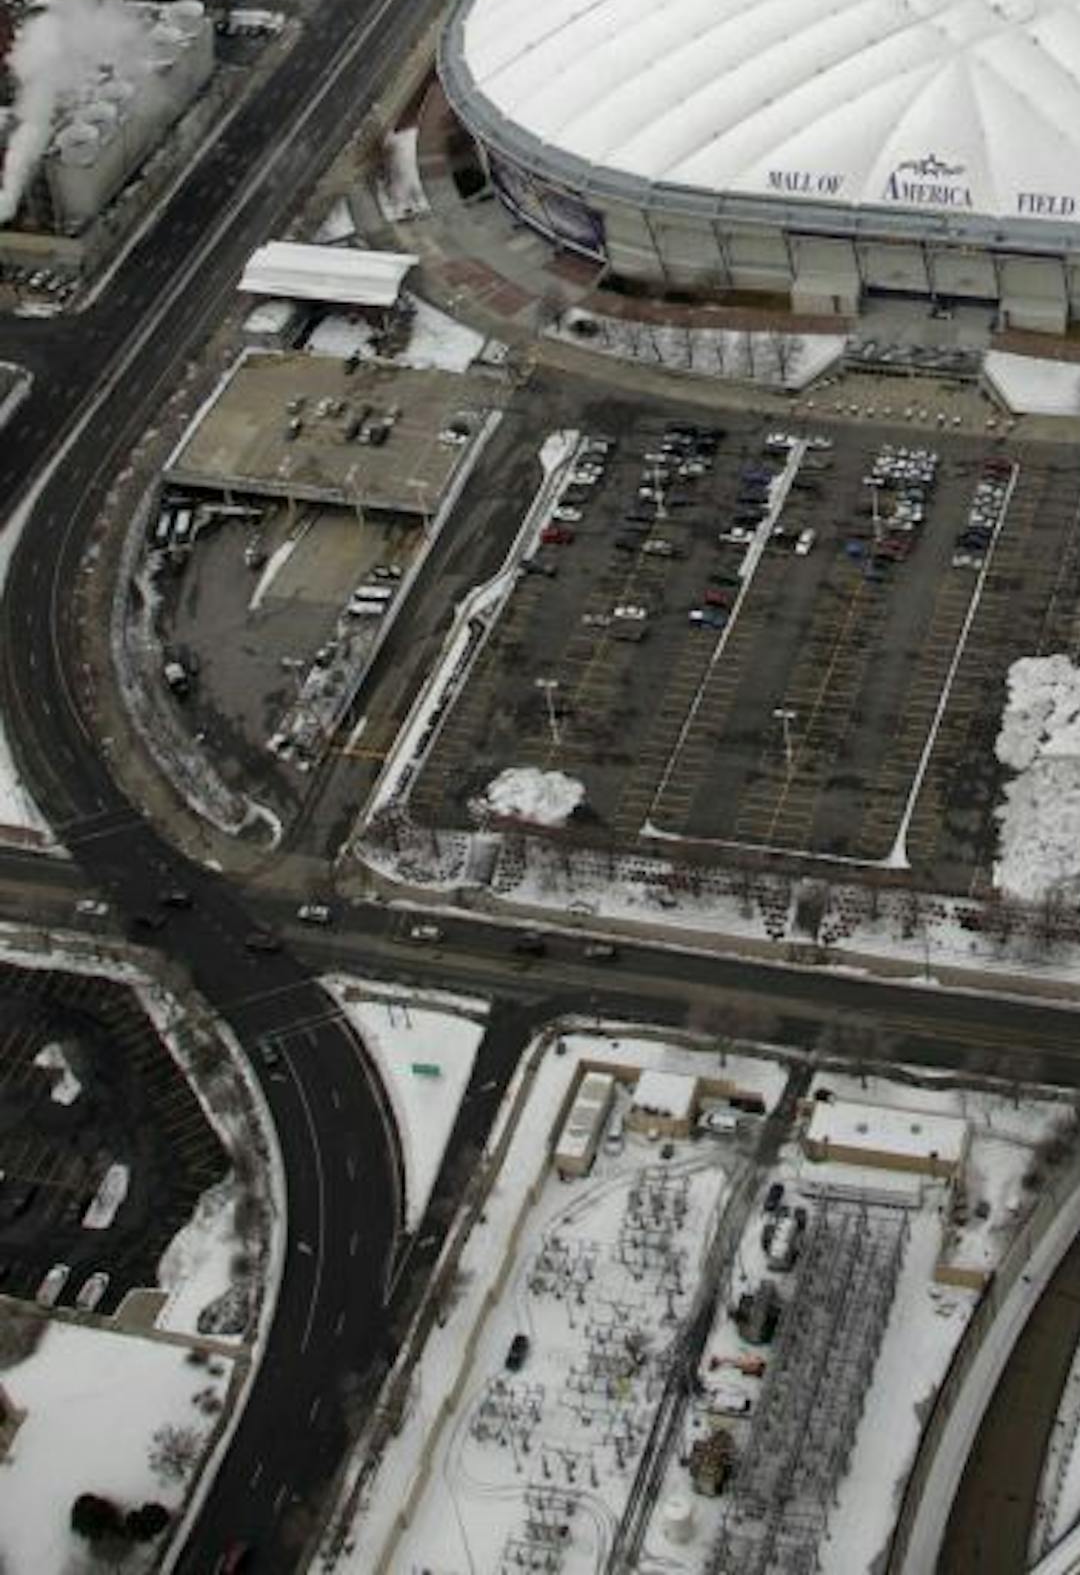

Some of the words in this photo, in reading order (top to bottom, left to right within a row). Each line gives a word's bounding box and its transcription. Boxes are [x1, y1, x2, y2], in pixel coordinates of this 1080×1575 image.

[767, 171, 815, 193] MALL
[817, 175, 844, 194] OF
[882, 172, 973, 207] AMERICA
[1017, 193, 1076, 215] FIELD
